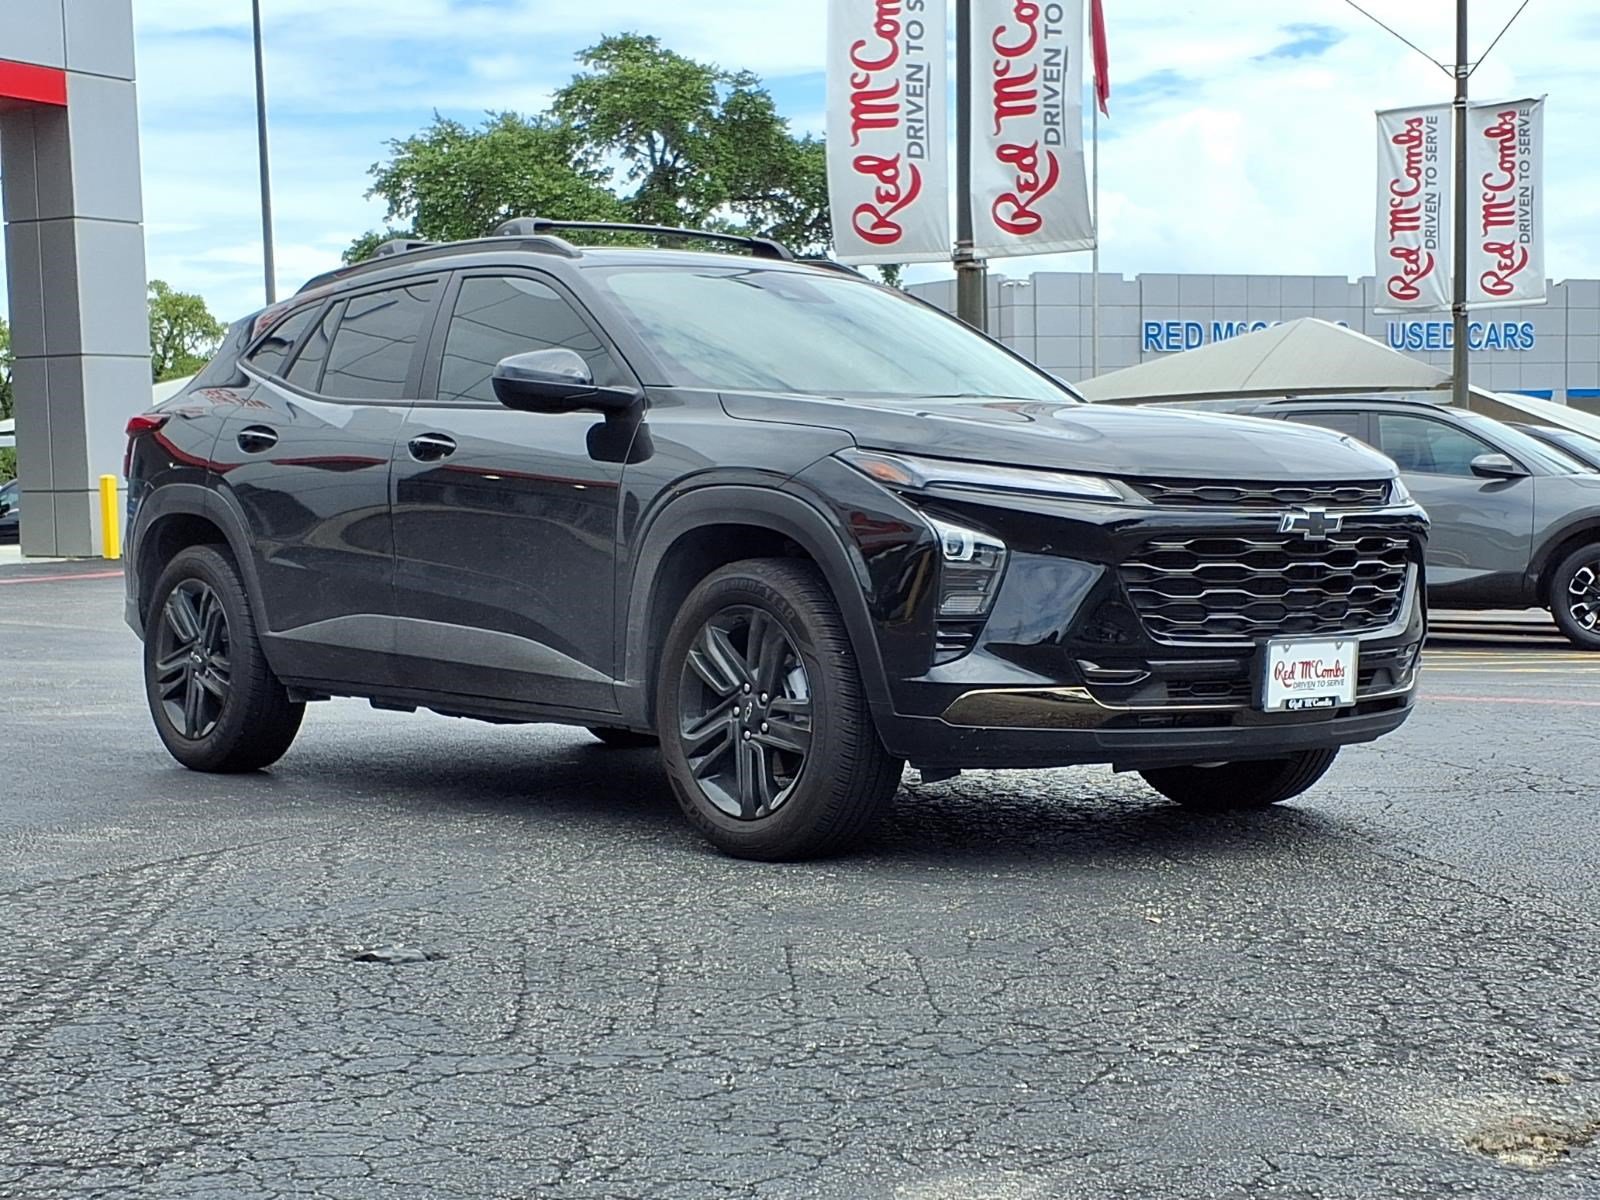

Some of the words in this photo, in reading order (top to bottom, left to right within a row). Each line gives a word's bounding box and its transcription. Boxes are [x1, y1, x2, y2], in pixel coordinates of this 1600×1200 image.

[905, 19, 925, 56] TO
[1044, 3, 1064, 40] TO
[906, 62, 925, 160] DRIVEN
[1043, 47, 1062, 147] DRIVEN
[1425, 115, 1439, 163] SERVE
[1518, 108, 1531, 156] SERVE
[852, 152, 922, 245] Red
[991, 140, 1060, 236] Red
[1388, 117, 1424, 243] McCombs
[1424, 167, 1438, 189] TO
[1481, 110, 1518, 238] McCombs
[1518, 161, 1531, 182] TO
[1424, 192, 1437, 250] DRIVEN
[1518, 186, 1531, 244] DRIVEN
[1387, 245, 1435, 300] Red
[1480, 240, 1528, 296] Red
[1143, 321, 1204, 351] RED
[1389, 322, 1454, 349] USED
[1467, 322, 1535, 349] CARS
[1274, 660, 1297, 688] Red
[1298, 659, 1345, 679] McCombs
[1292, 681, 1316, 690] DRIVEN
[1317, 680, 1326, 688] TO
[1326, 679, 1345, 687] SERVE
